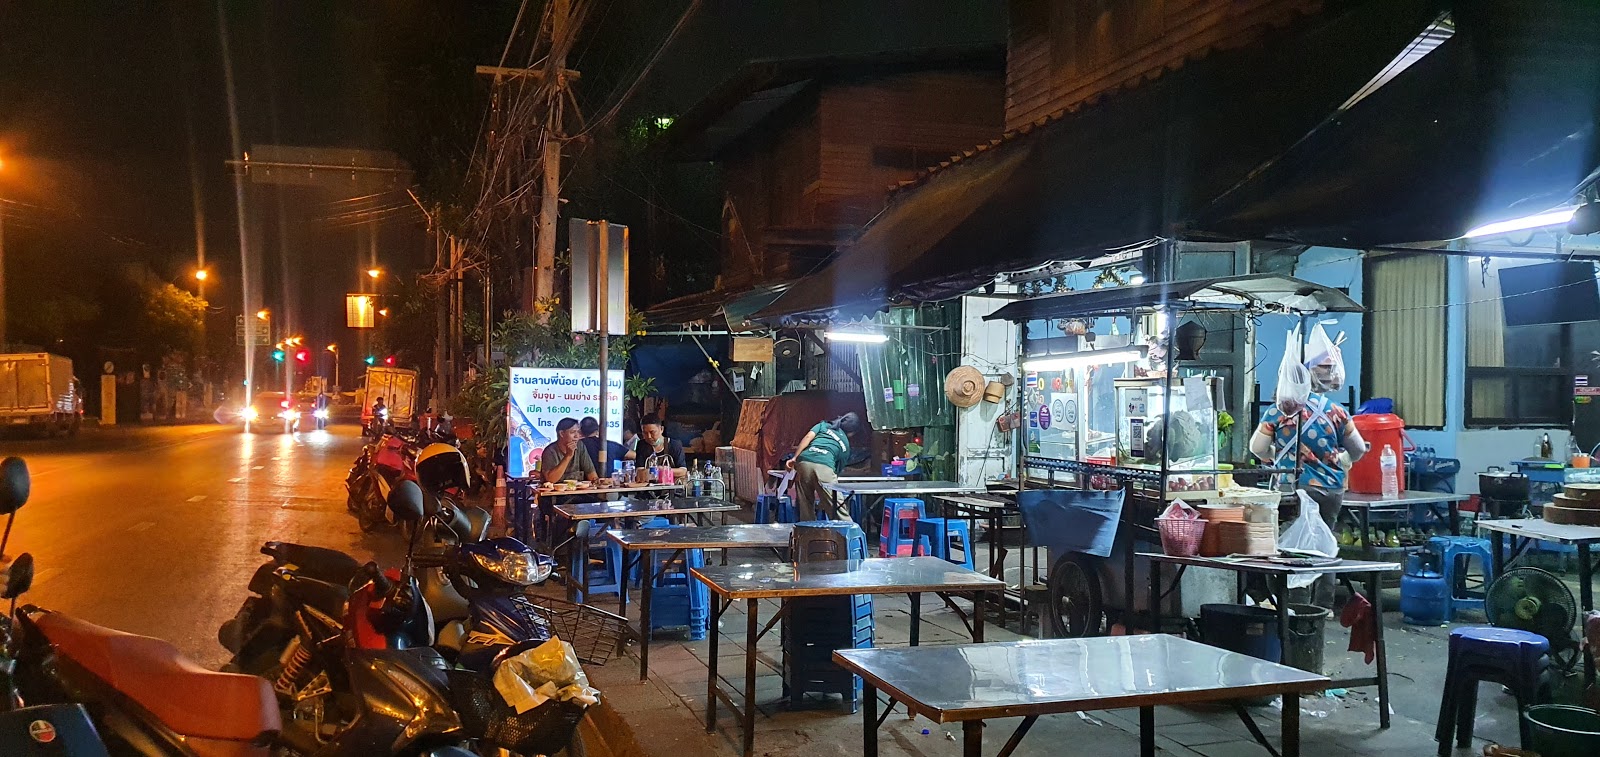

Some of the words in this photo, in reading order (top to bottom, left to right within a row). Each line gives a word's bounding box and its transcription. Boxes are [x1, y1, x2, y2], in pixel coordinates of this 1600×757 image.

[513, 373, 578, 386] ร้านลาบพี่น้อย
[532, 388, 555, 402] จิ้มจุ่ม
[564, 392, 591, 401] นมย่าง
[526, 404, 542, 413] เปิด
[547, 406, 571, 414] 16:00
[537, 417, 555, 427] โทร.
